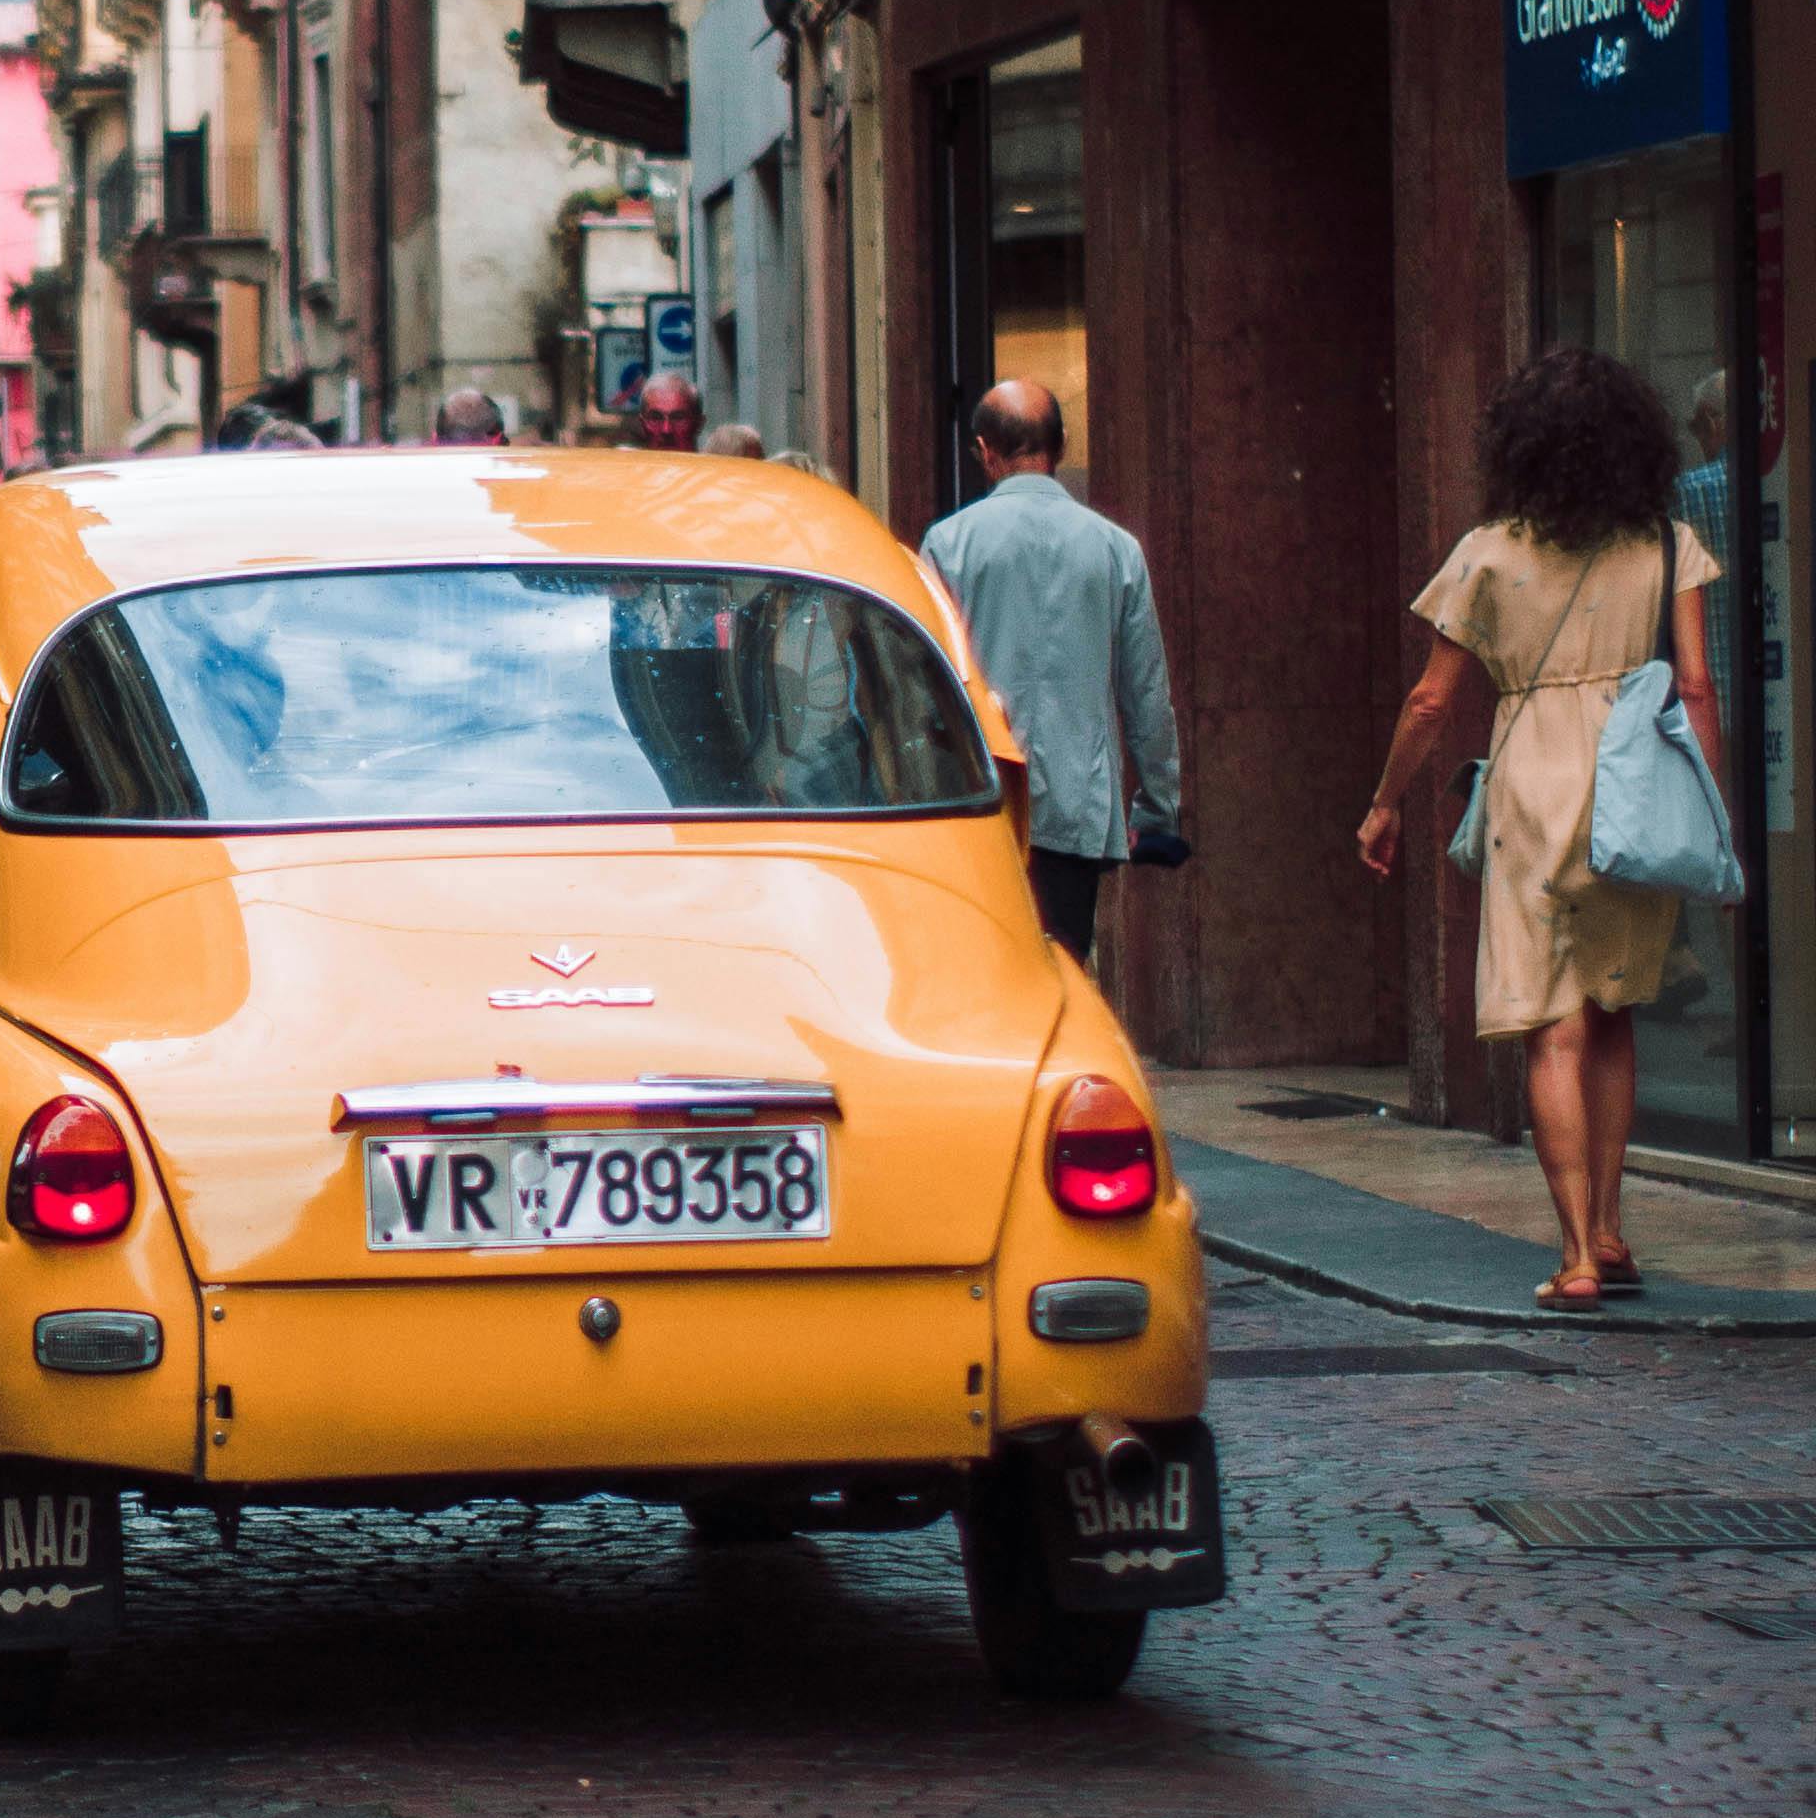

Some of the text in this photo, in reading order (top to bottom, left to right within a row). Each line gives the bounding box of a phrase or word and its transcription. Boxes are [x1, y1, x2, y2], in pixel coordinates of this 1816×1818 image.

[488, 987, 655, 1010] SAAB
[388, 1142, 816, 1232] VR 789358
